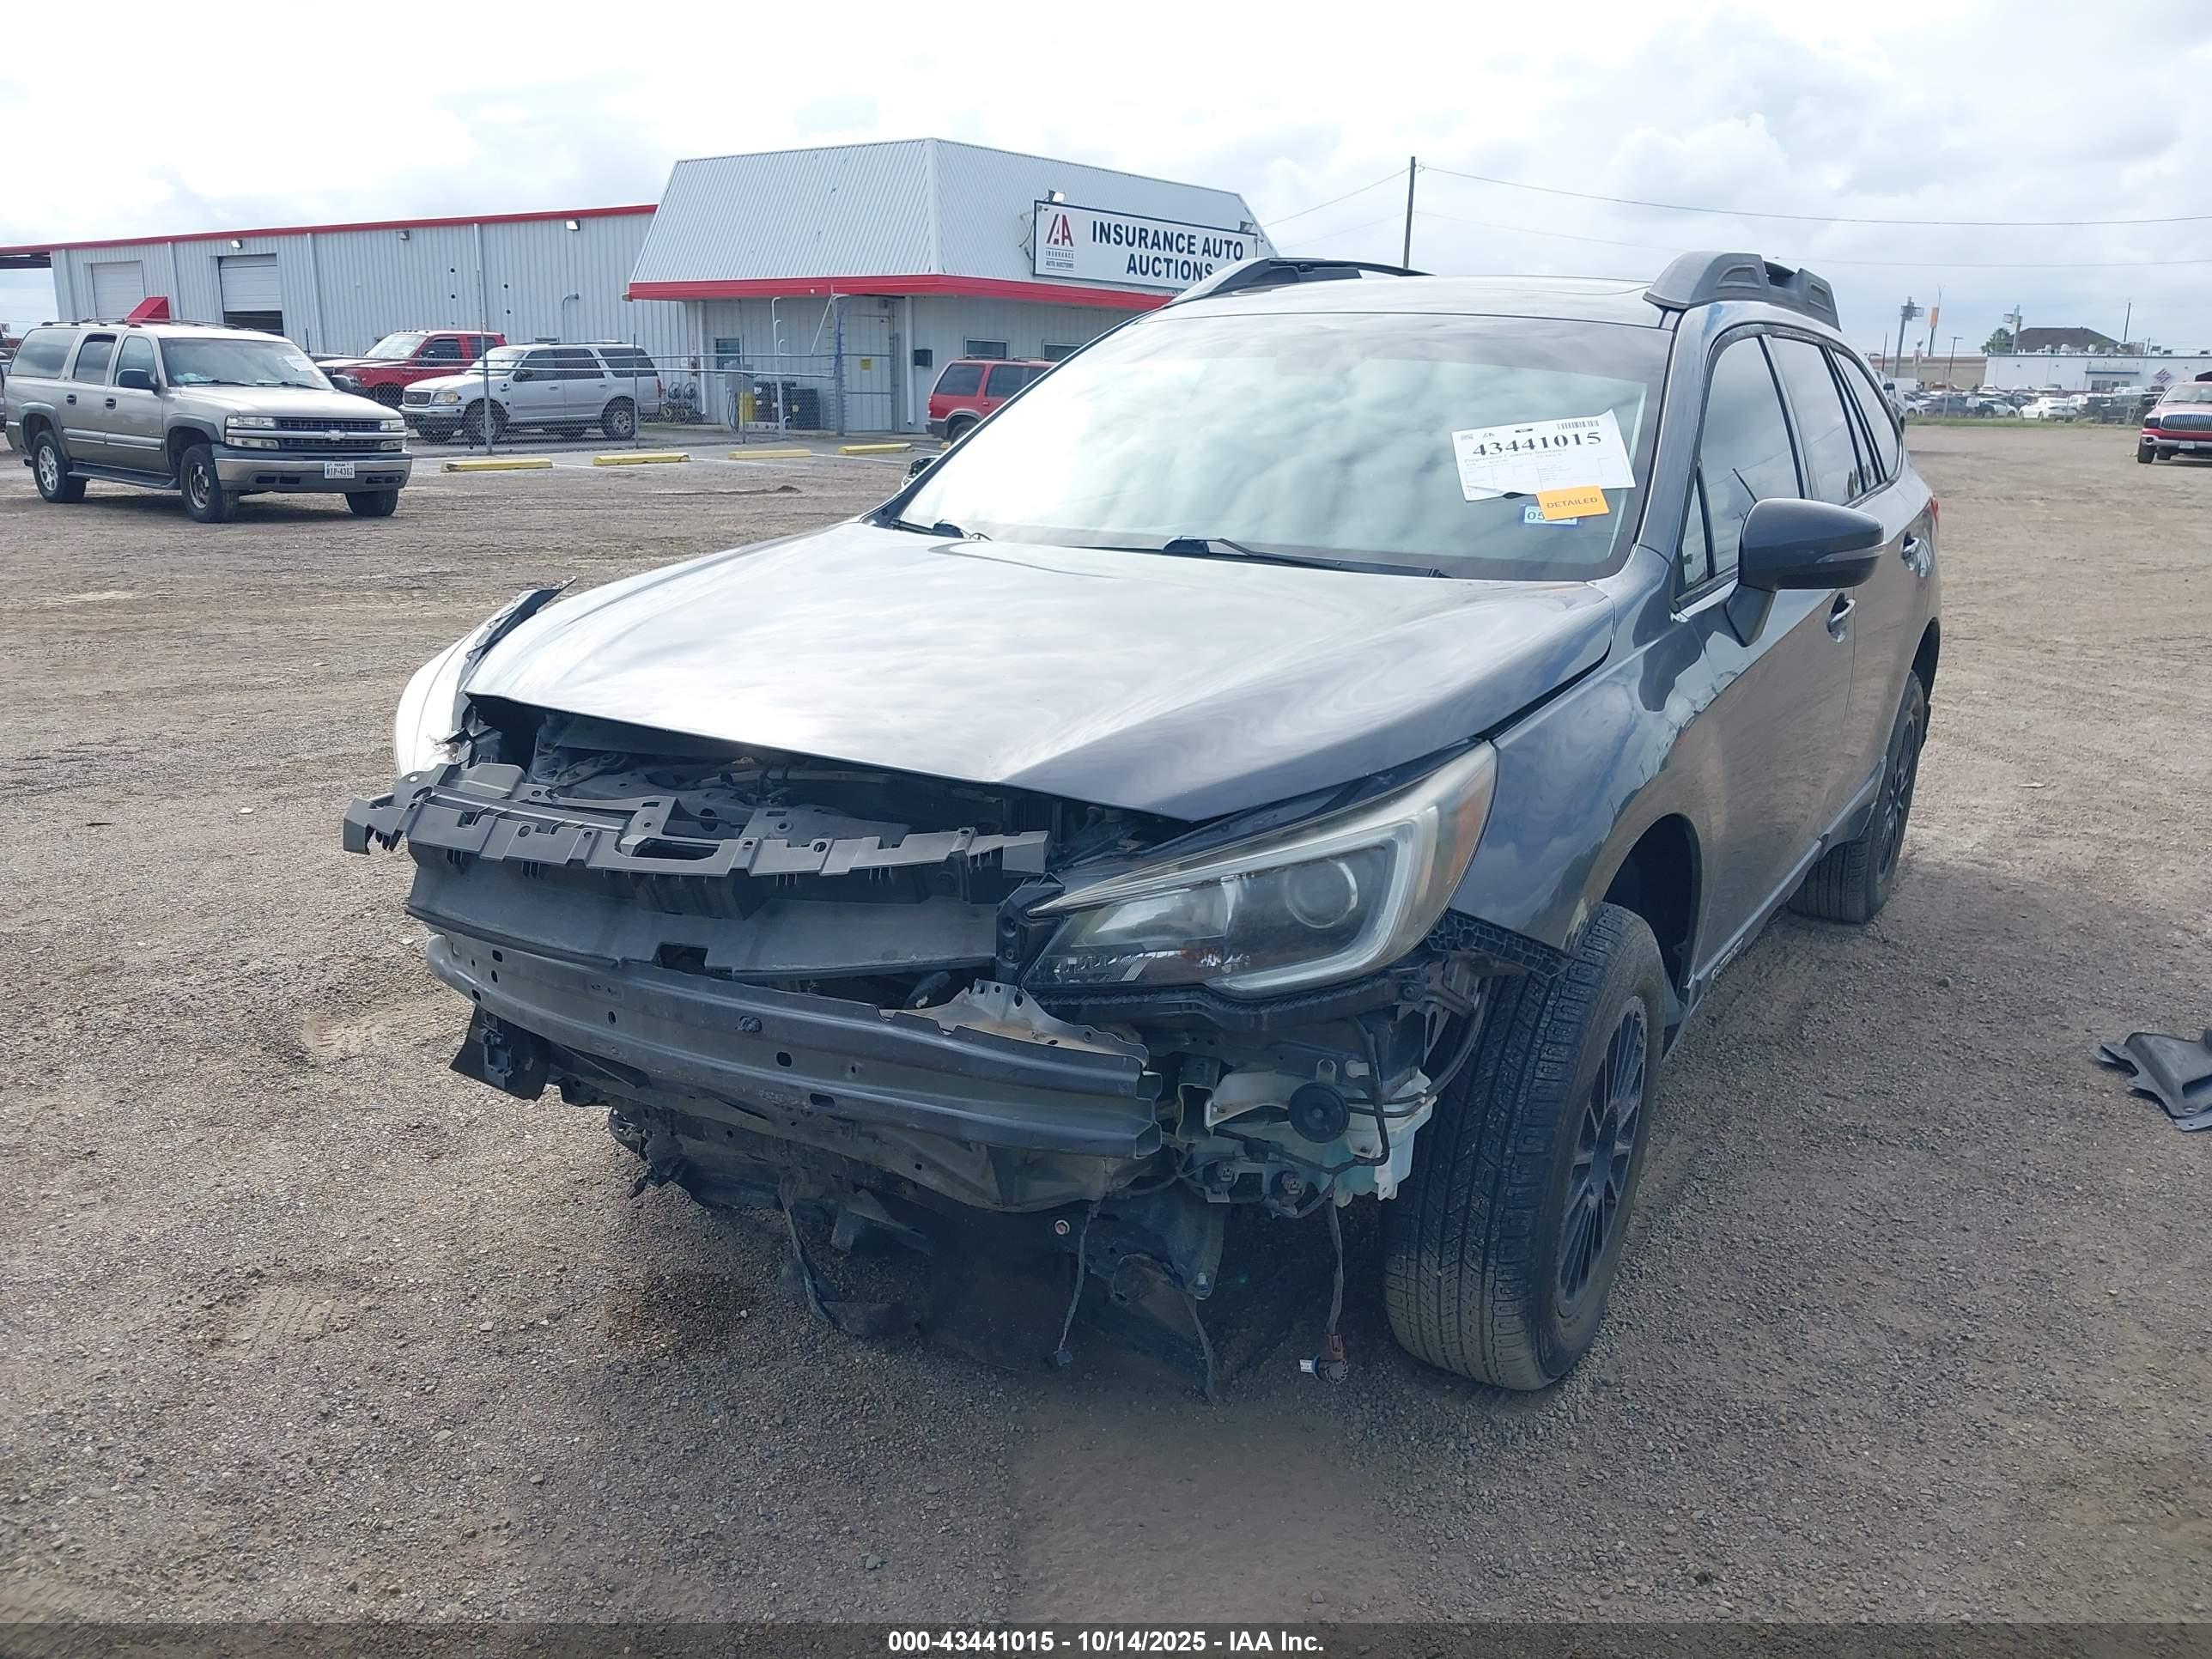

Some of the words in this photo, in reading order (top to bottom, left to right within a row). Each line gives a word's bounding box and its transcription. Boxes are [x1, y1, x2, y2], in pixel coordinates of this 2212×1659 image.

[1092, 220, 1196, 255] INSURANCE
[1201, 237, 1243, 262] AUTO
[1046, 250, 1073, 259] INSURANCE
[1127, 253, 1213, 282] AUCTIONS
[1473, 432, 1601, 455] 43441015
[1547, 497, 1598, 508] DETAILED
